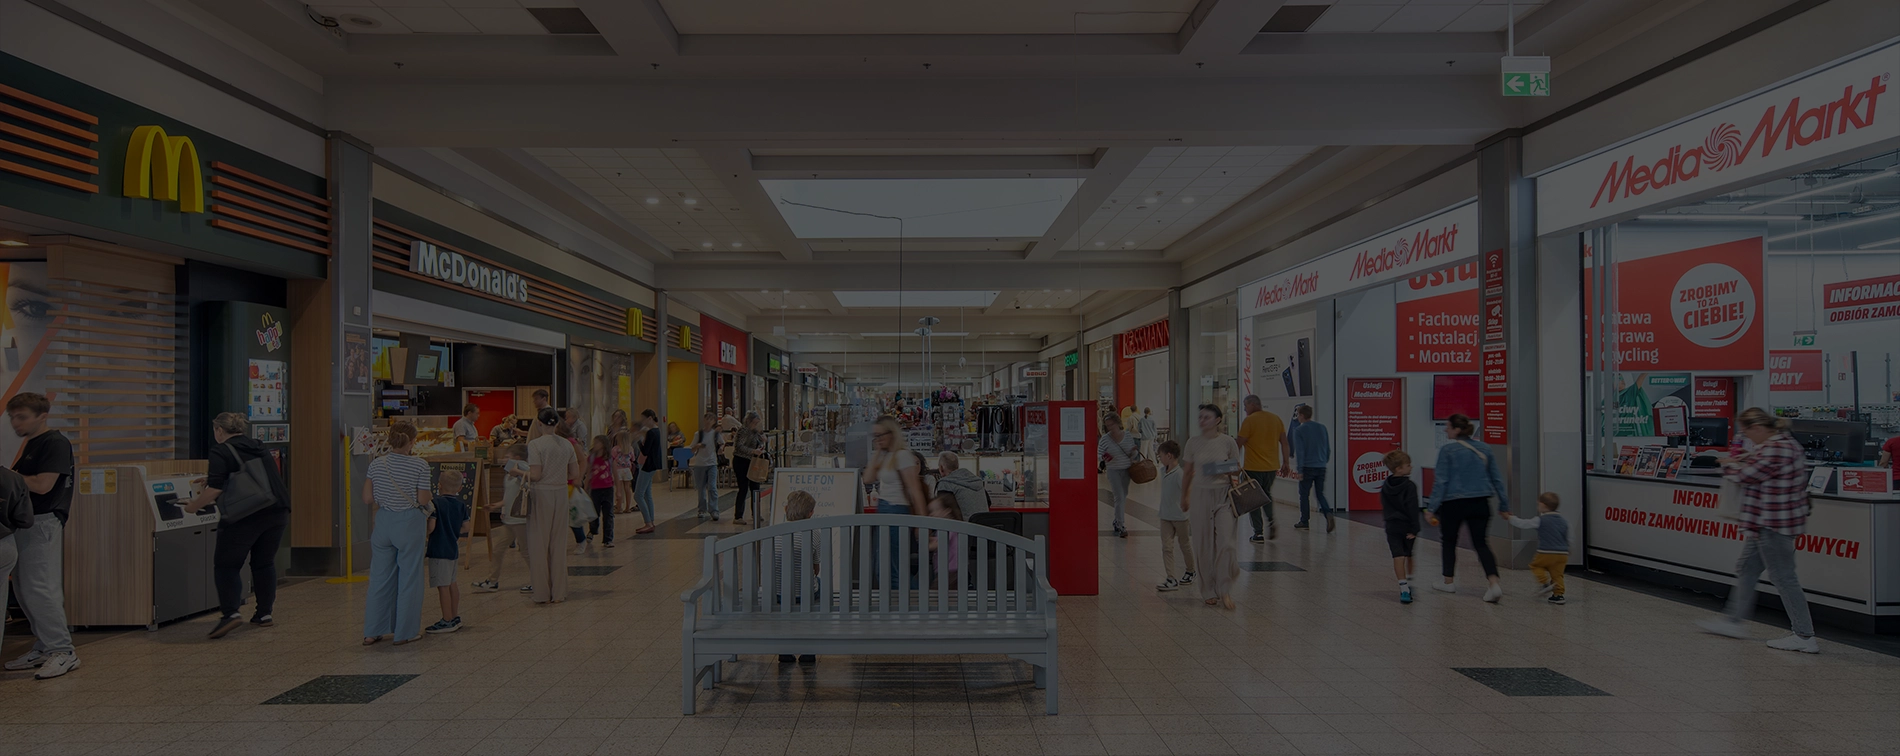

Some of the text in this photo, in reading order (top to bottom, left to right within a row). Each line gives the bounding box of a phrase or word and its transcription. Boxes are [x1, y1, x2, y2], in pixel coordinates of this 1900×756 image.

[416, 240, 528, 303] McDonald's
[1679, 280, 1738, 303] ZROBIMY
[1697, 297, 1719, 309] TO ZA
[1418, 312, 1479, 326] Fachowe
[1683, 301, 1744, 330] CIEBIE!
[1830, 307, 1869, 322] ODBIÓR
[1418, 330, 1479, 347] Instalacj
[1419, 349, 1472, 363] Montaż
[1769, 357, 1792, 369] UGI
[788, 474, 834, 485] TELEFON
[1605, 507, 1646, 526] ODBIÓR
